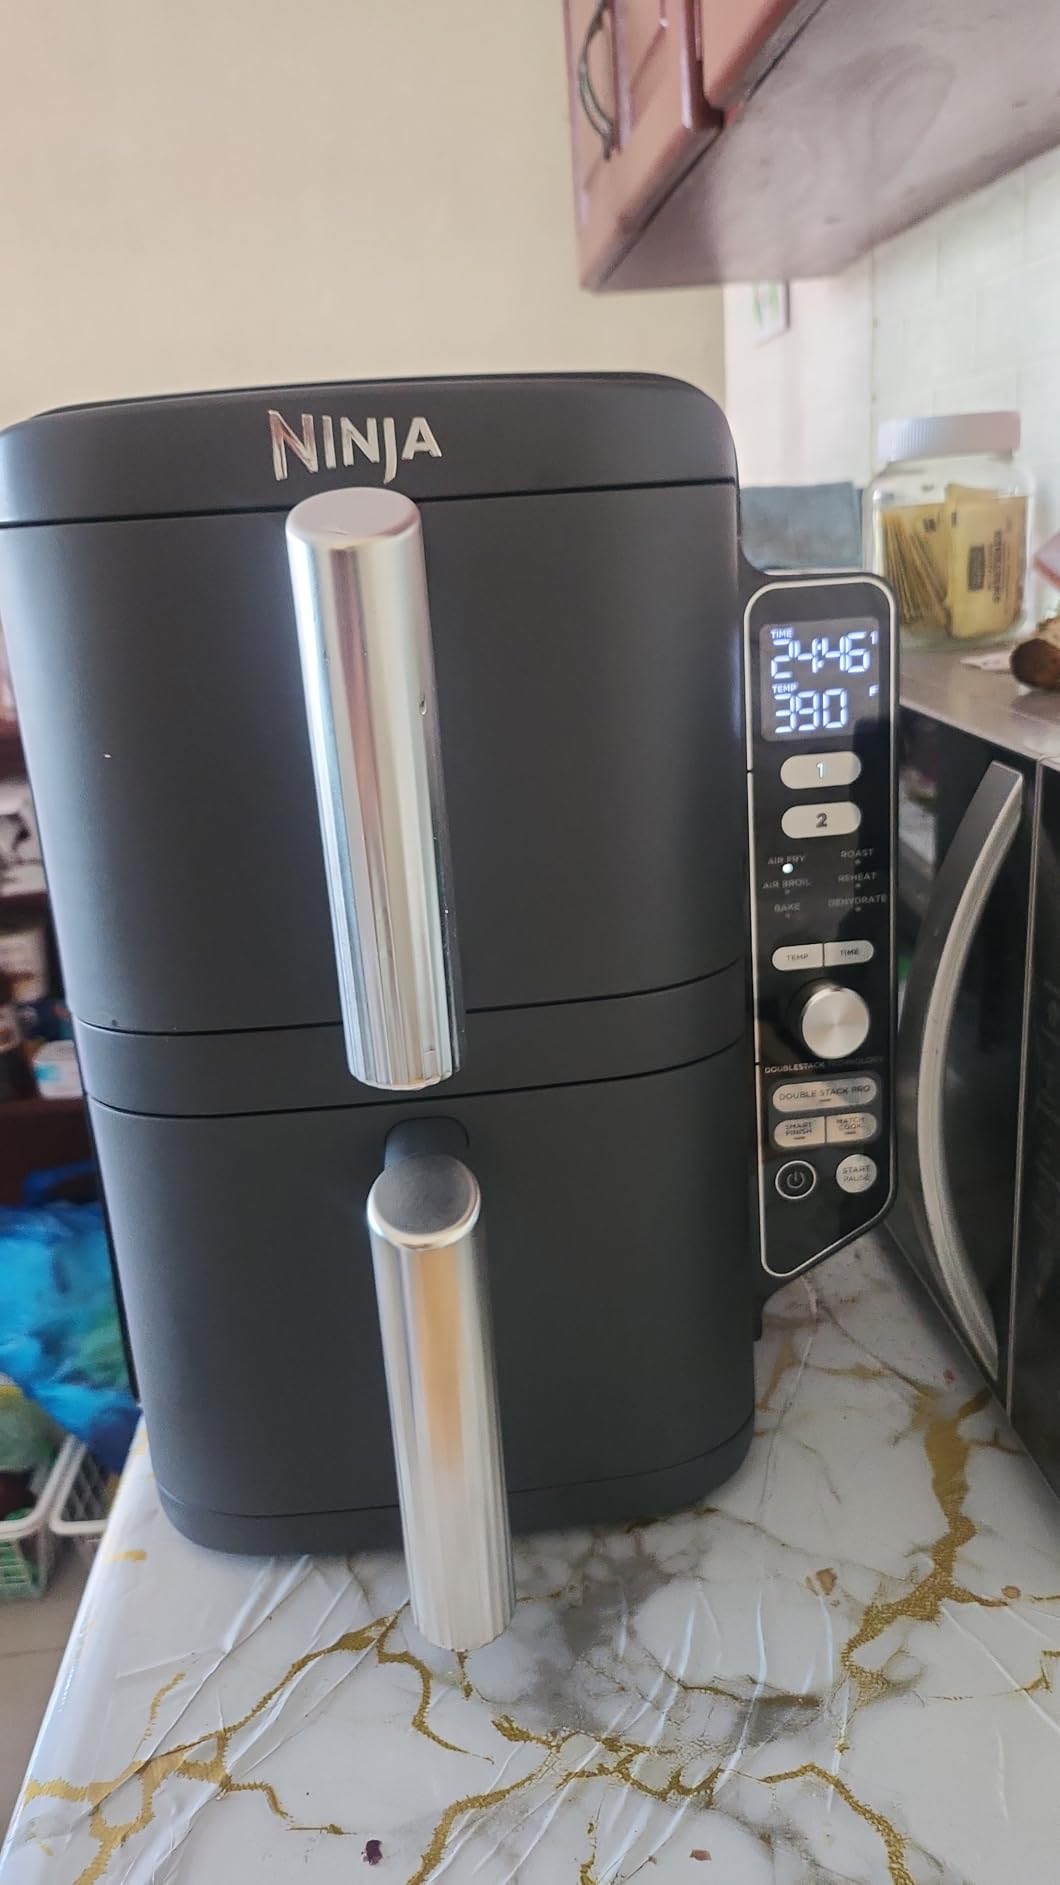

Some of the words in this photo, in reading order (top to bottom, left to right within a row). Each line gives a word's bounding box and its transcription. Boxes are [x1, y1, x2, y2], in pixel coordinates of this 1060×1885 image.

[267, 409, 442, 485] NINJA
[770, 627, 794, 639] TIME
[772, 682, 798, 694] TEMP
[775, 688, 848, 733] 390
[869, 684, 879, 696] F
[816, 762, 825, 779] 1
[816, 813, 828, 828] 2
[841, 848, 874, 859] ROAST
[768, 856, 784, 865] AIR
[786, 855, 806, 864] FRY
[838, 872, 877, 883] REHEAT
[762, 881, 779, 889] AIR
[782, 878, 811, 889] BROIL
[828, 894, 887, 908] DEHYDRATE
[774, 902, 801, 912] BAKE
[786, 953, 809, 961] TEMP
[840, 948, 859, 956] TIME
[764, 1062, 825, 1074] DOUBLESTACK
[779, 1090, 816, 1101] DOUBLE
[819, 1086, 849, 1096] STACK
[852, 1084, 871, 1093] PRO
[836, 1116, 865, 1125] MATCH
[838, 1123, 862, 1132] COOK
[842, 1166, 871, 1174] START
[843, 1174, 870, 1182] PAUSE
